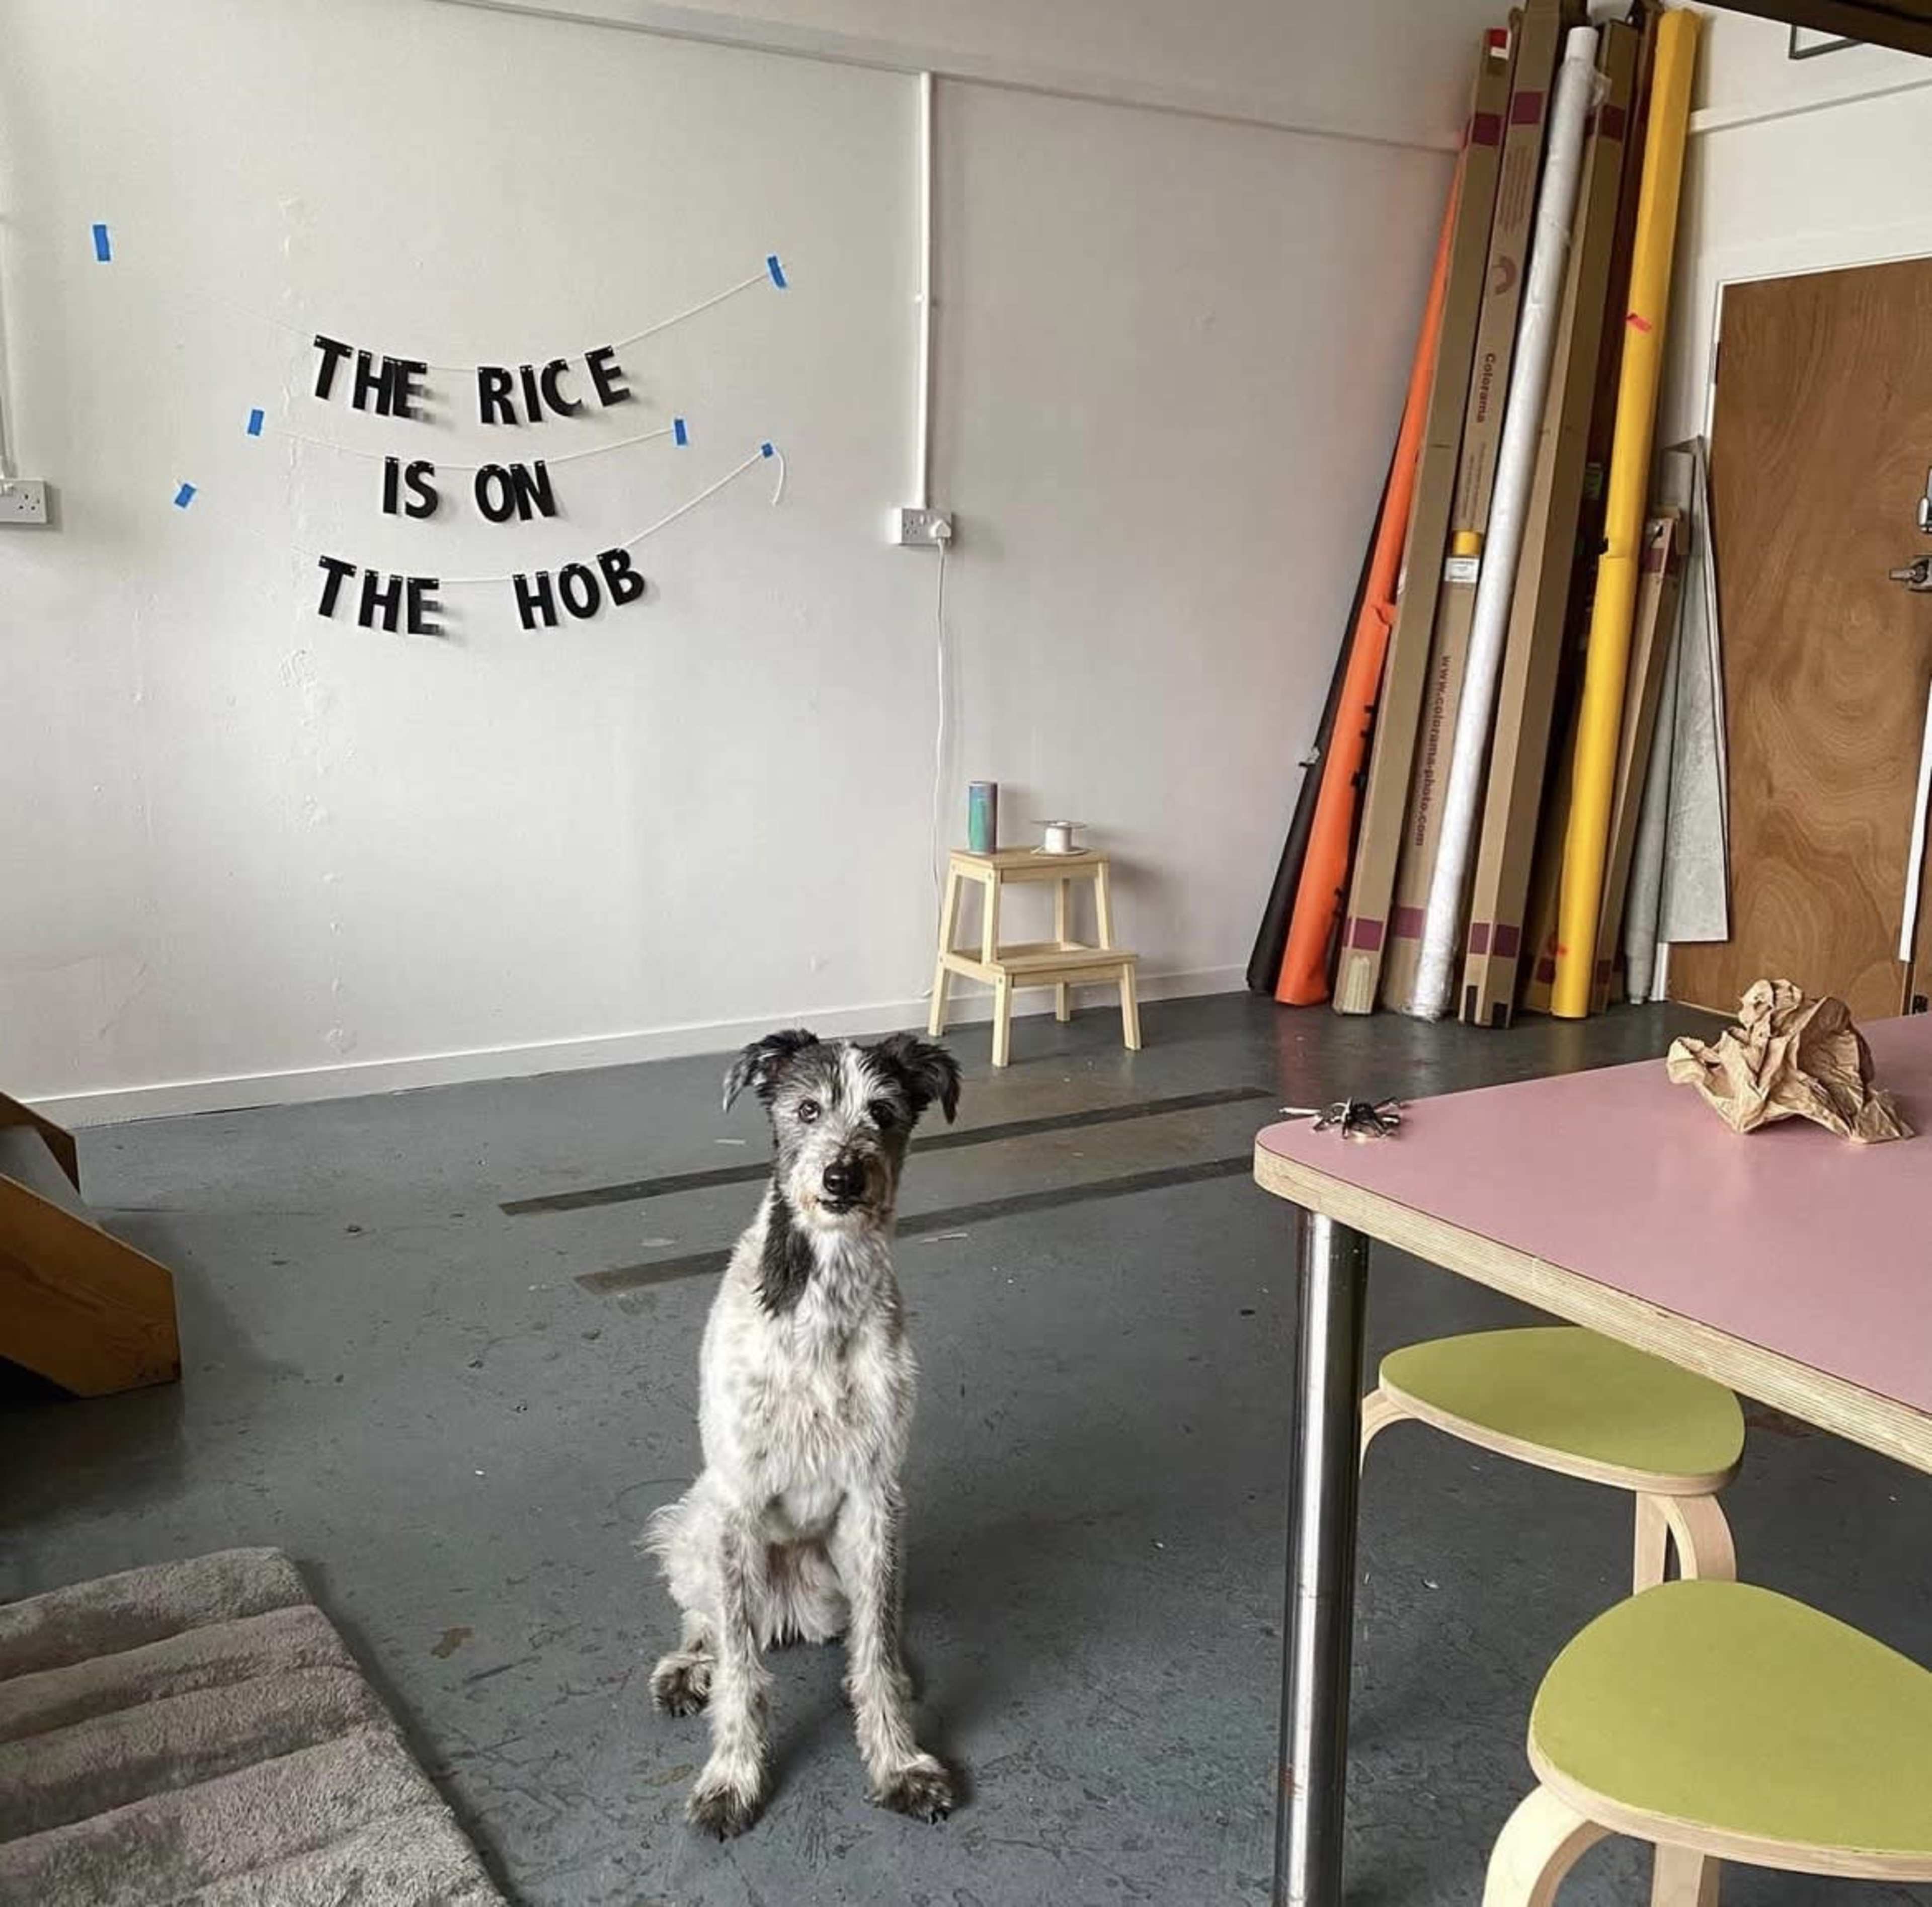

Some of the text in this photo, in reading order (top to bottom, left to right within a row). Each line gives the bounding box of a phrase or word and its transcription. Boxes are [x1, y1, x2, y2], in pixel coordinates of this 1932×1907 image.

[313, 334, 632, 425] THE RICE
[1477, 353, 1496, 423] Colorama
[383, 456, 556, 523] IS ON
[318, 548, 645, 635] THE HOB
[1415, 655, 1452, 847] www.colorama-photo.com
